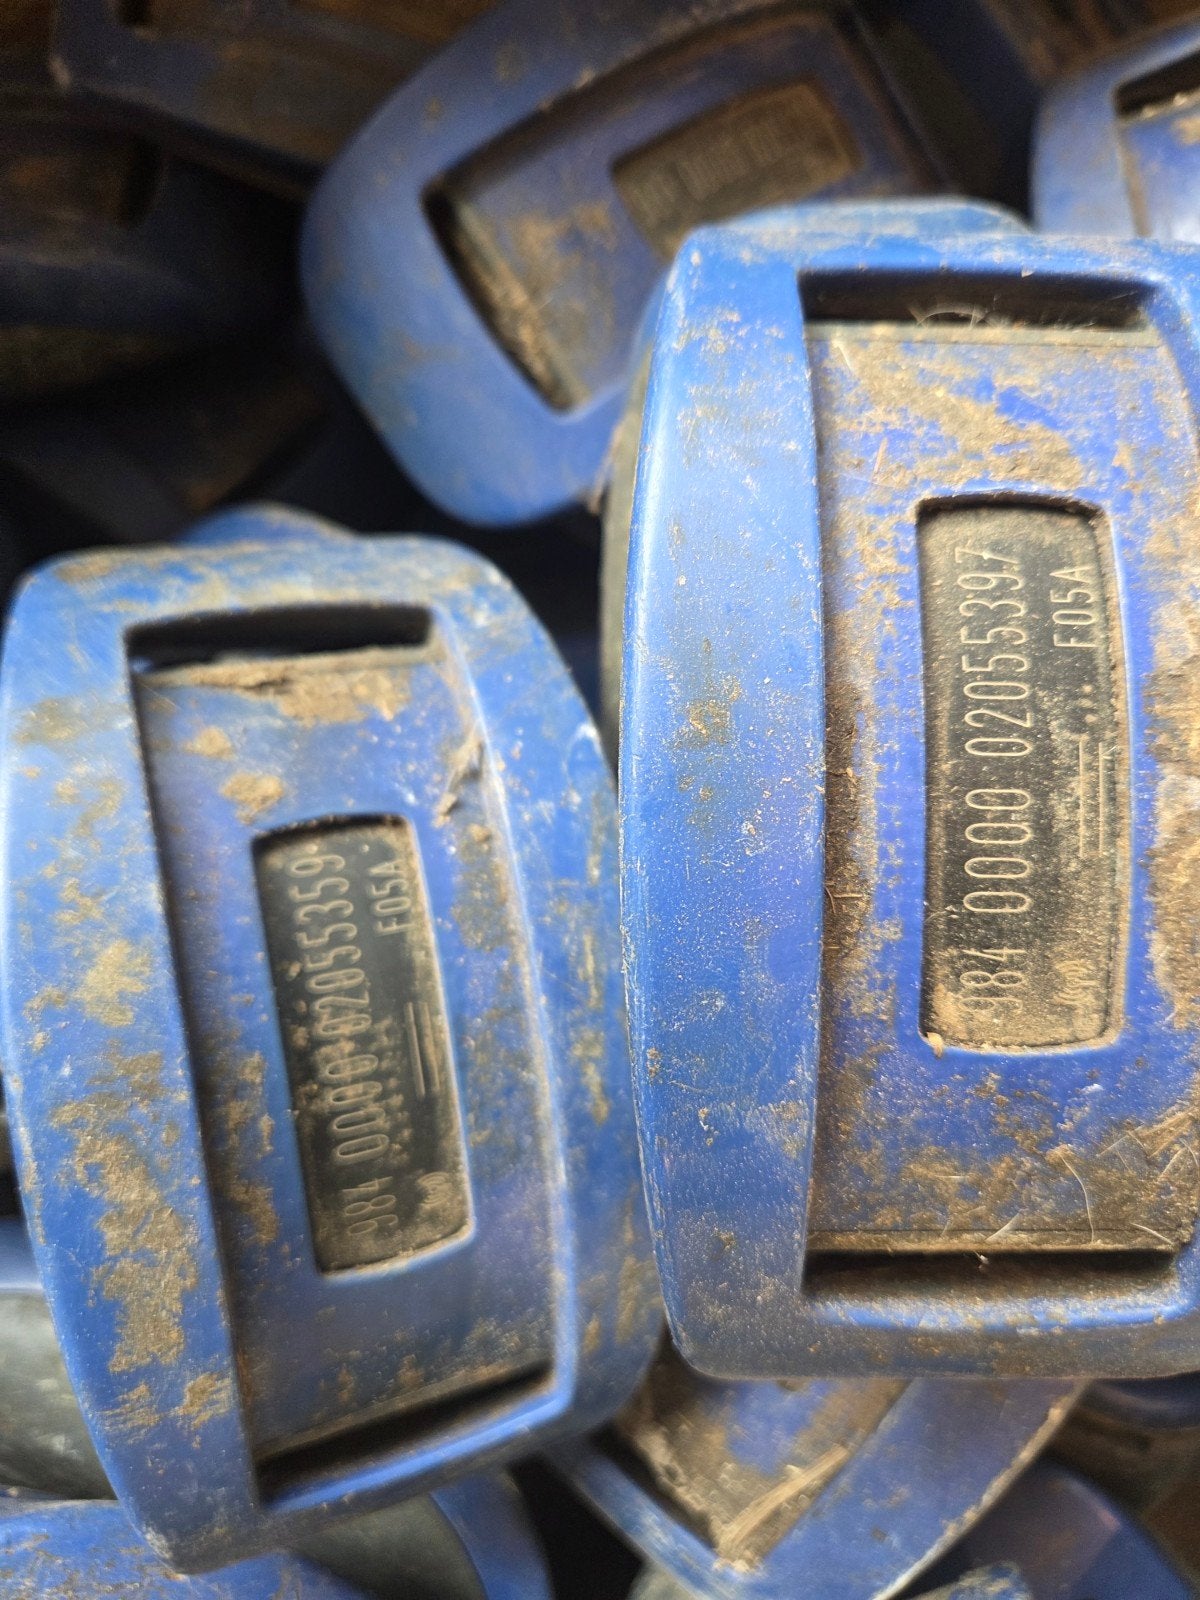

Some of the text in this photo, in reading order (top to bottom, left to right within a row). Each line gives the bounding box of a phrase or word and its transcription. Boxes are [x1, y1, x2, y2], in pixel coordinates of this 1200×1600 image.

[1051, 566, 1098, 647] F05A
[963, 787, 1033, 915] 0000
[371, 860, 412, 935] F05A
[958, 946, 1028, 1013] 984
[326, 1053, 389, 1165] 0000
[340, 1174, 399, 1237] 984
